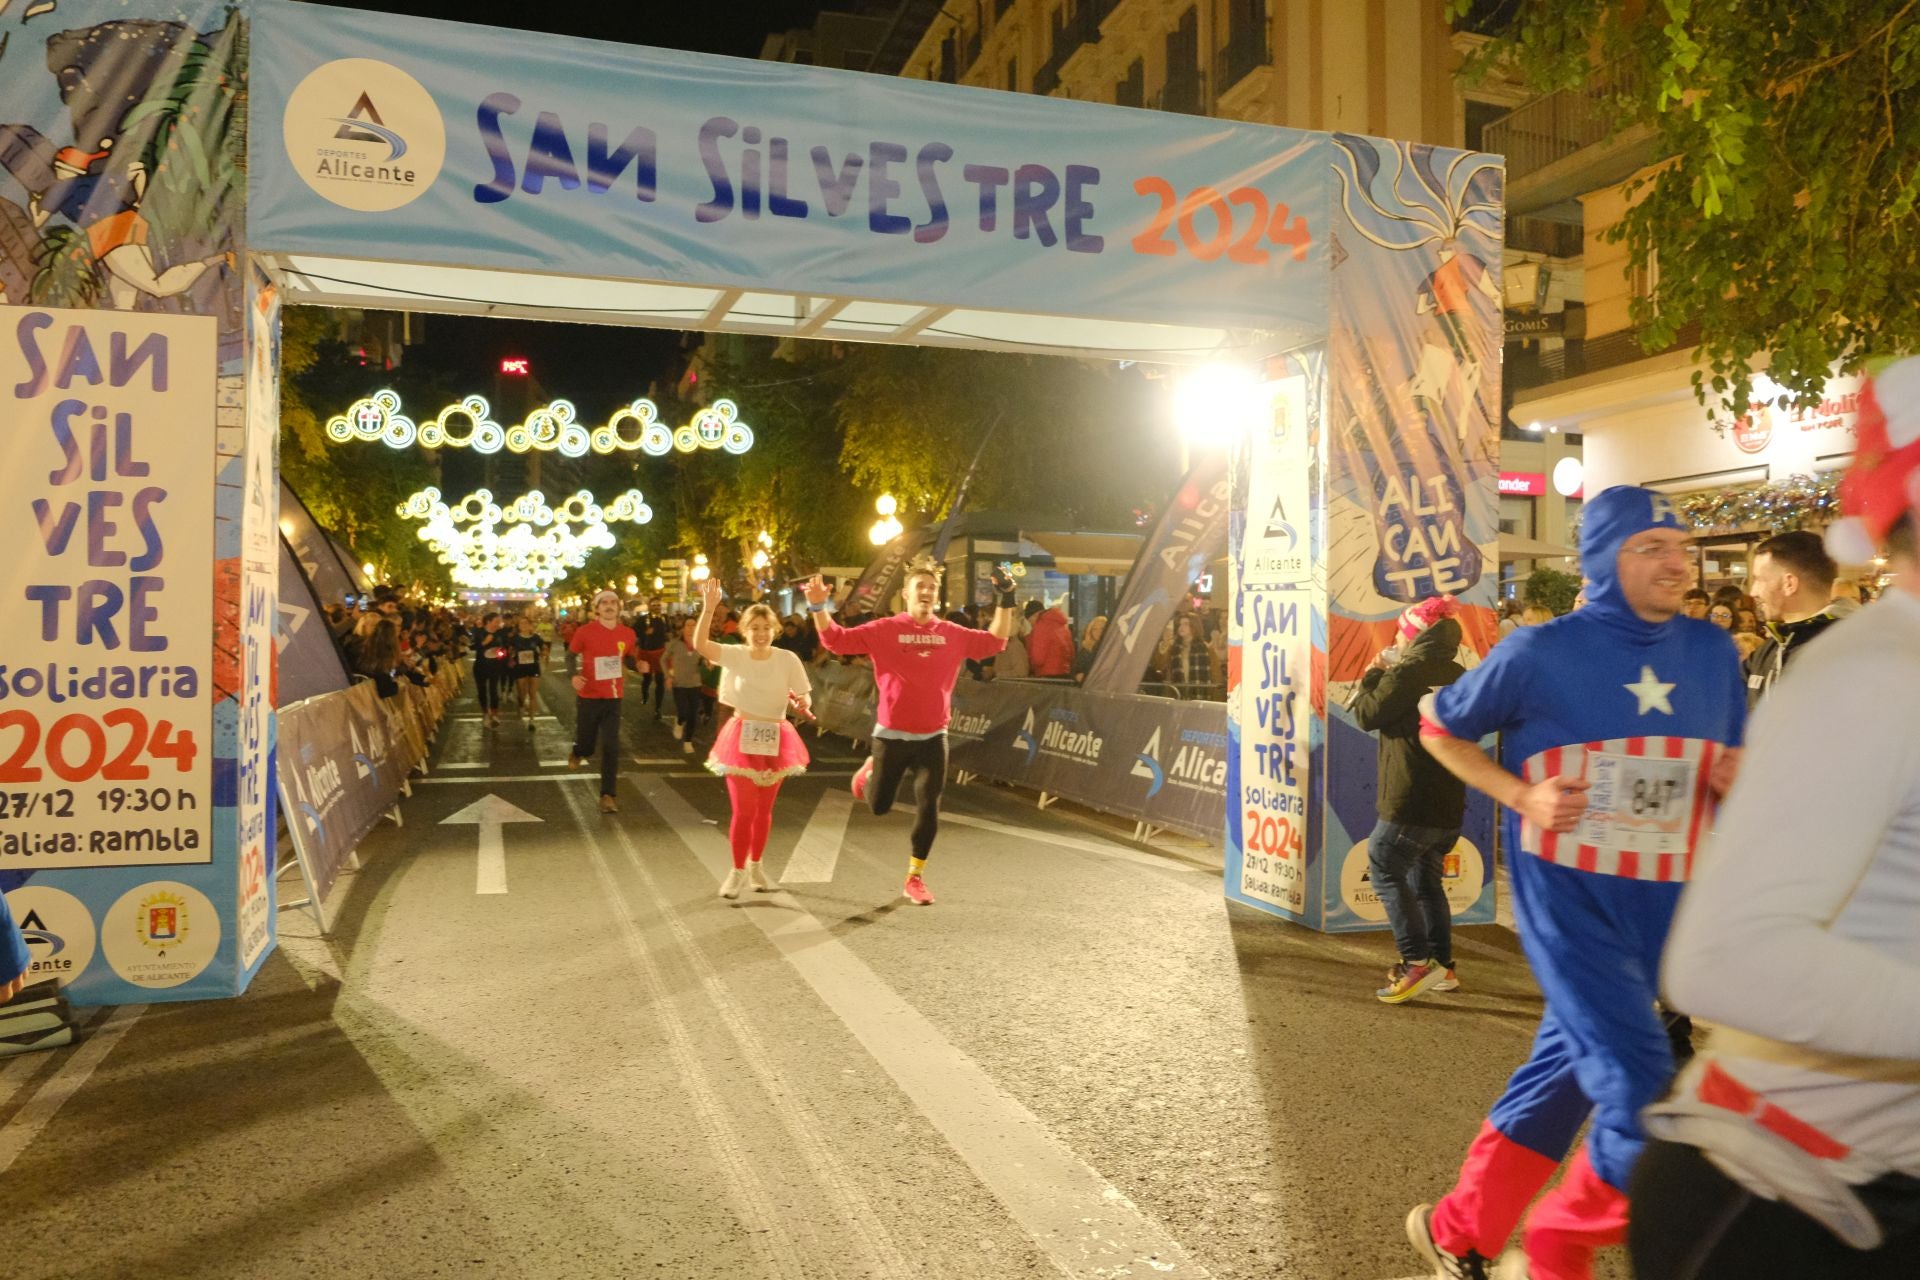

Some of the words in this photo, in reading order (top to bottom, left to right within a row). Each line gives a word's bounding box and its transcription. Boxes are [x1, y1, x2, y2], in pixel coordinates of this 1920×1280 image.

[316, 148, 367, 160] DEPORTES
[317, 158, 416, 183] Alicante
[473, 92, 657, 204] SAN
[853, 176, 1312, 265] 2024
[15, 311, 168, 399] SAN
[1379, 474, 1454, 516] ALI
[31, 486, 168, 573] VES
[1160, 480, 1229, 571] Alica
[1383, 520, 1461, 563] CAN
[859, 545, 906, 613] licante
[1254, 557, 1302, 571] Alicante
[1384, 557, 1469, 598] TE
[25, 575, 169, 652] TRE
[1252, 594, 1297, 642] SAN
[753, 728, 776, 743] 2194
[949, 707, 992, 735] licante
[1256, 691, 1296, 741] VES
[0, 708, 198, 784] 2024
[1040, 721, 1104, 759] Alicante
[1169, 745, 1228, 786] Alica
[1254, 742, 1297, 787] TRE
[97, 787, 172, 813] 19:30
[177, 789, 197, 811] h
[1632, 778, 1676, 815] 847
[0, 830, 83, 857] alida:
[1247, 810, 1303, 860] 2024
[31, 958, 73, 971] ante
